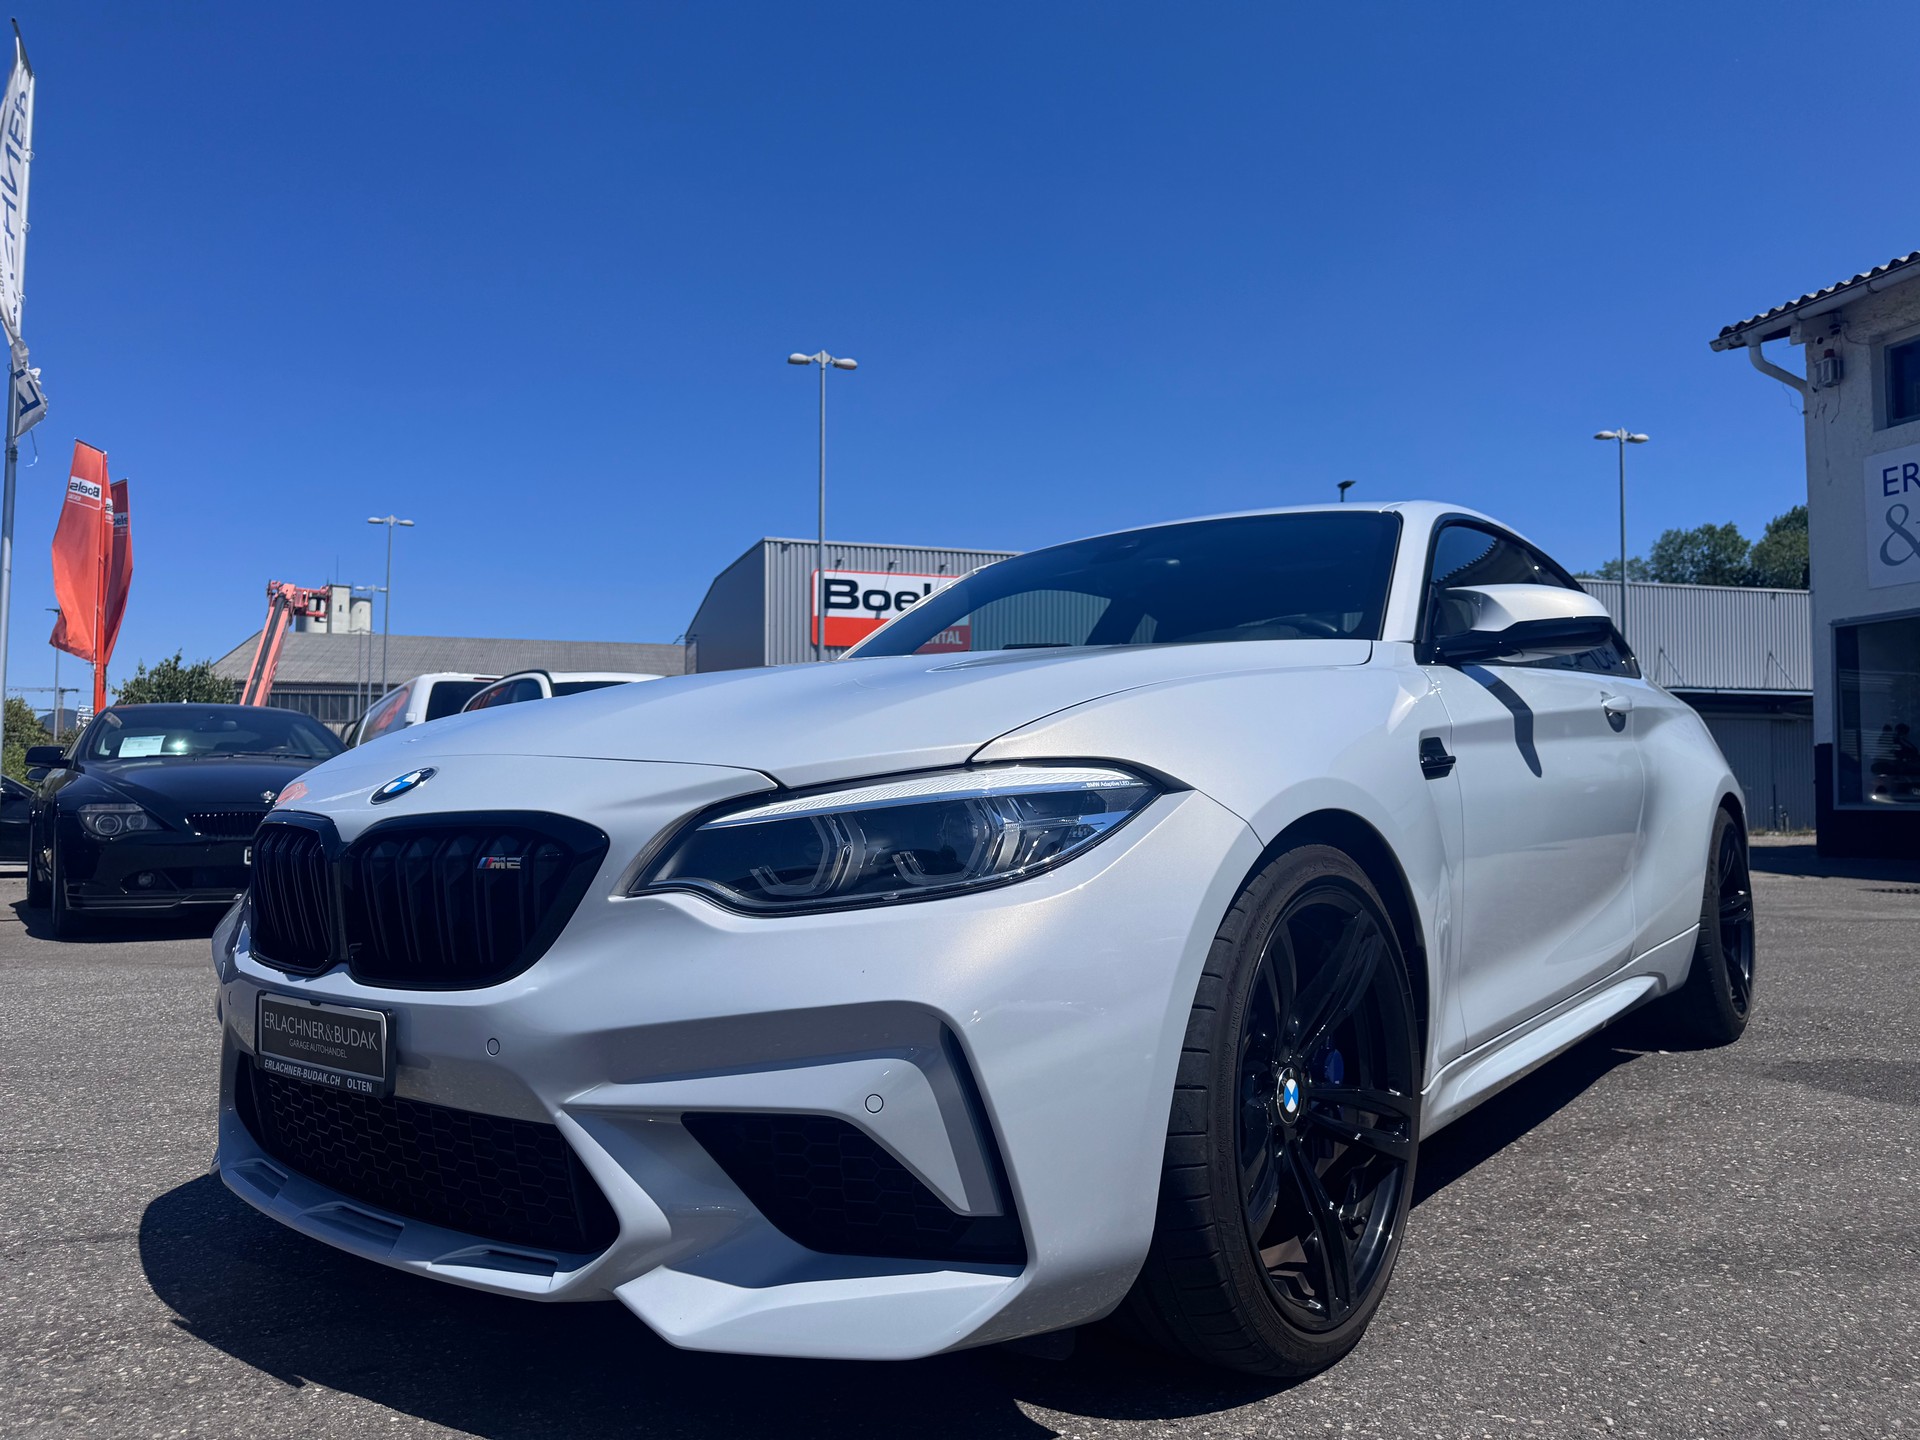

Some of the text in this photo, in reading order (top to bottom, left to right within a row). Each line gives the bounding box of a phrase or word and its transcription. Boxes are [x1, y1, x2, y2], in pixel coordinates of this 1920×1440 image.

[1882, 462, 1920, 497] ER
[1880, 503, 1920, 566] &
[926, 630, 963, 645] NTAL
[264, 1011, 378, 1051] ERLACHNER&BUDAK
[264, 1059, 373, 1093] ERLACHNER-BUDAK.CH OLTEN
